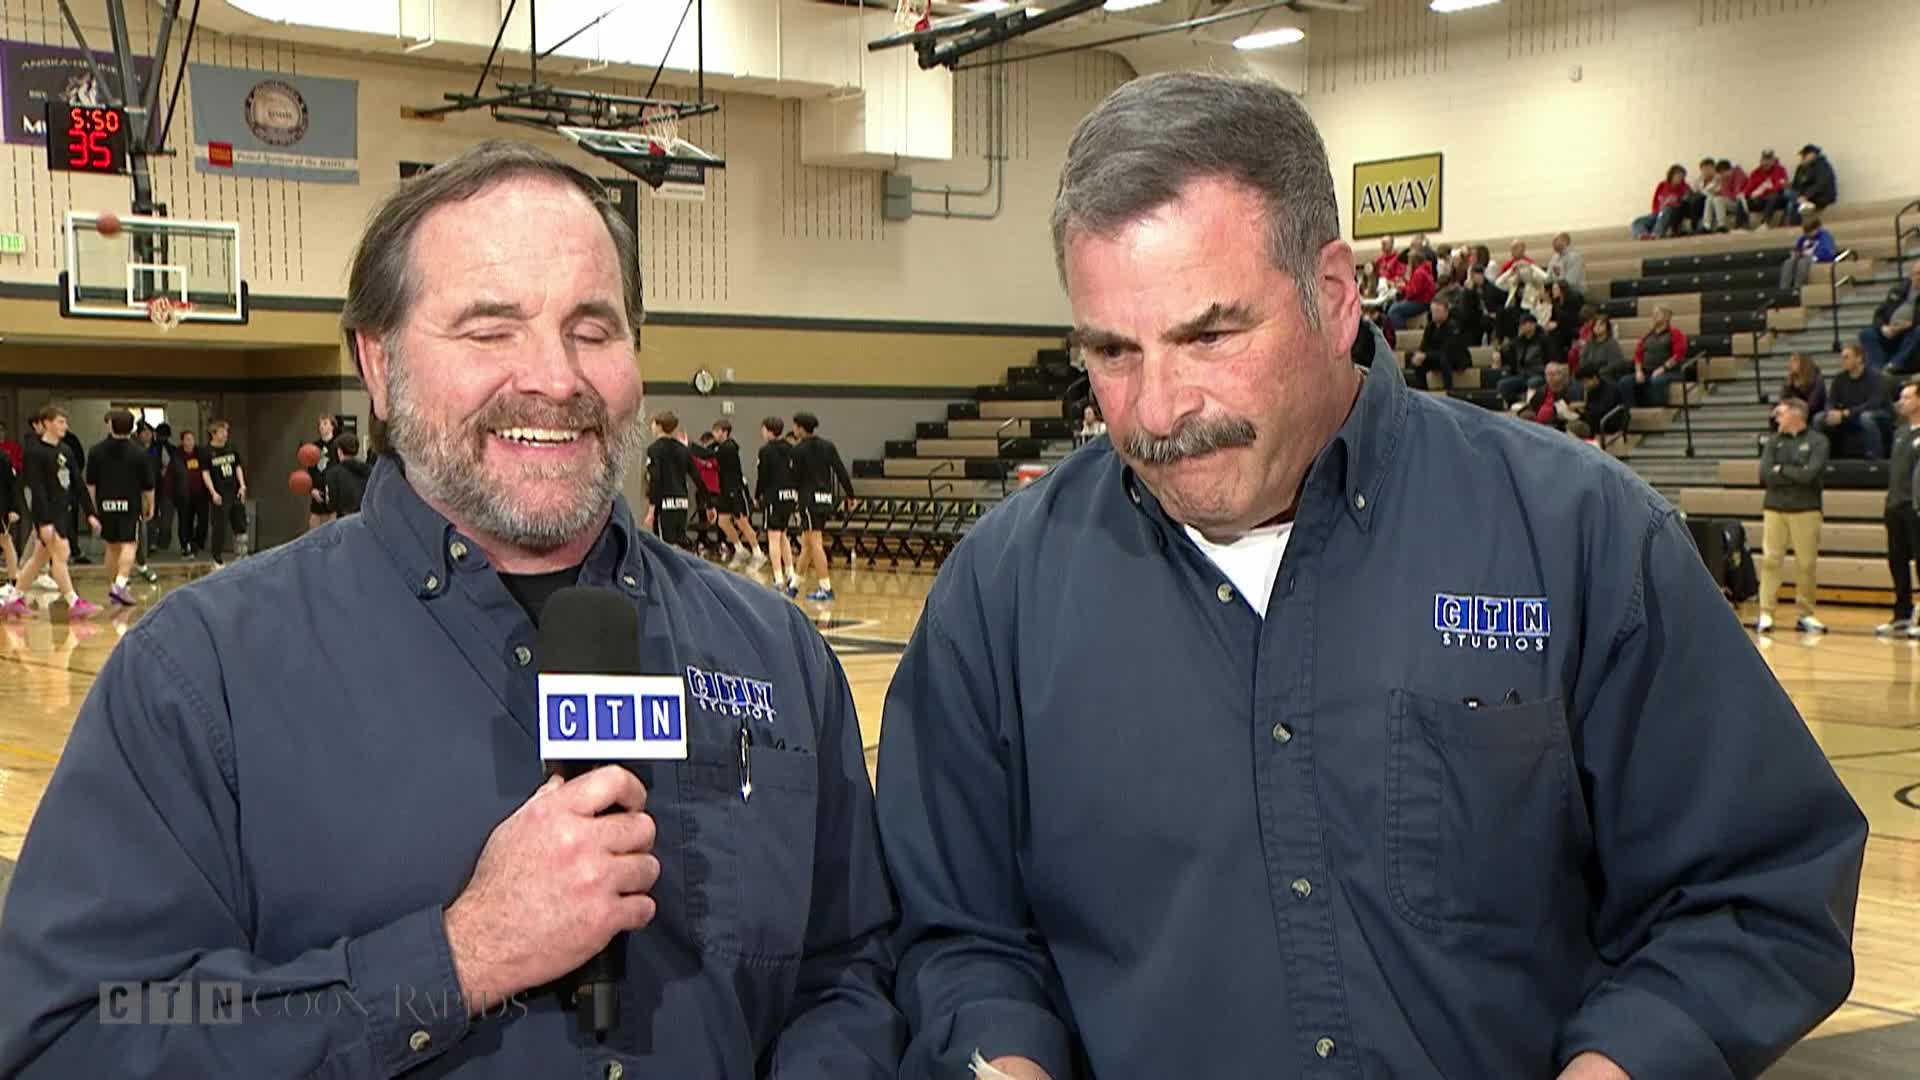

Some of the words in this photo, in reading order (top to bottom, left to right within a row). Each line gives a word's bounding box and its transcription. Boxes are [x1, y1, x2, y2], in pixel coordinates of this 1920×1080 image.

[71, 107, 119, 131] 5:50
[69, 129, 110, 168] 35
[1359, 175, 1435, 215] AWAY
[1441, 597, 1546, 634] CTN
[1442, 633, 1544, 651] STUDIOS
[689, 666, 771, 709] CTN
[557, 698, 671, 737] CTN
